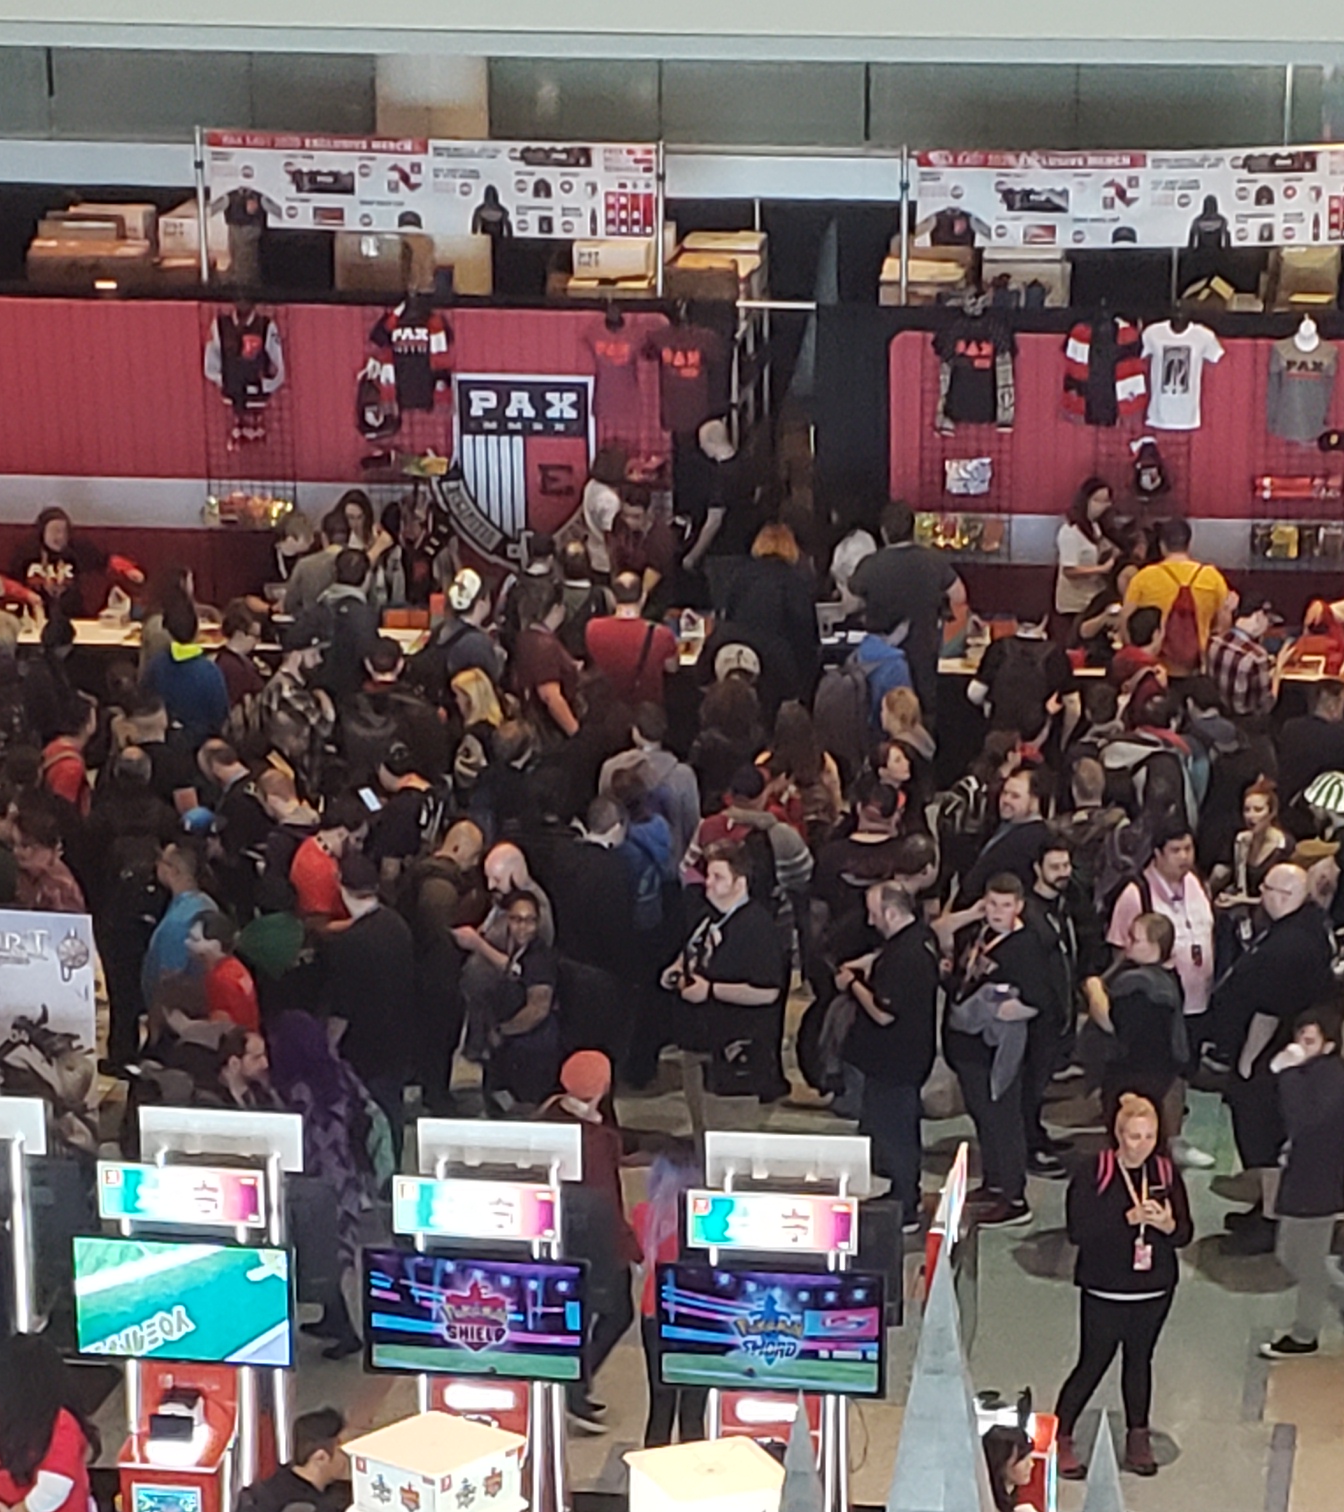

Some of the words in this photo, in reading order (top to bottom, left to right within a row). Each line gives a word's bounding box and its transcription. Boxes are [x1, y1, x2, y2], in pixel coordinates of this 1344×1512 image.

[371, 139, 413, 151] MERCH
[391, 327, 429, 342] PAX
[1286, 360, 1324, 372] PAX
[468, 389, 578, 419] PAX
[537, 463, 575, 497] E
[445, 1324, 506, 1343] SHIELD
[742, 1340, 797, 1359] SWORD
